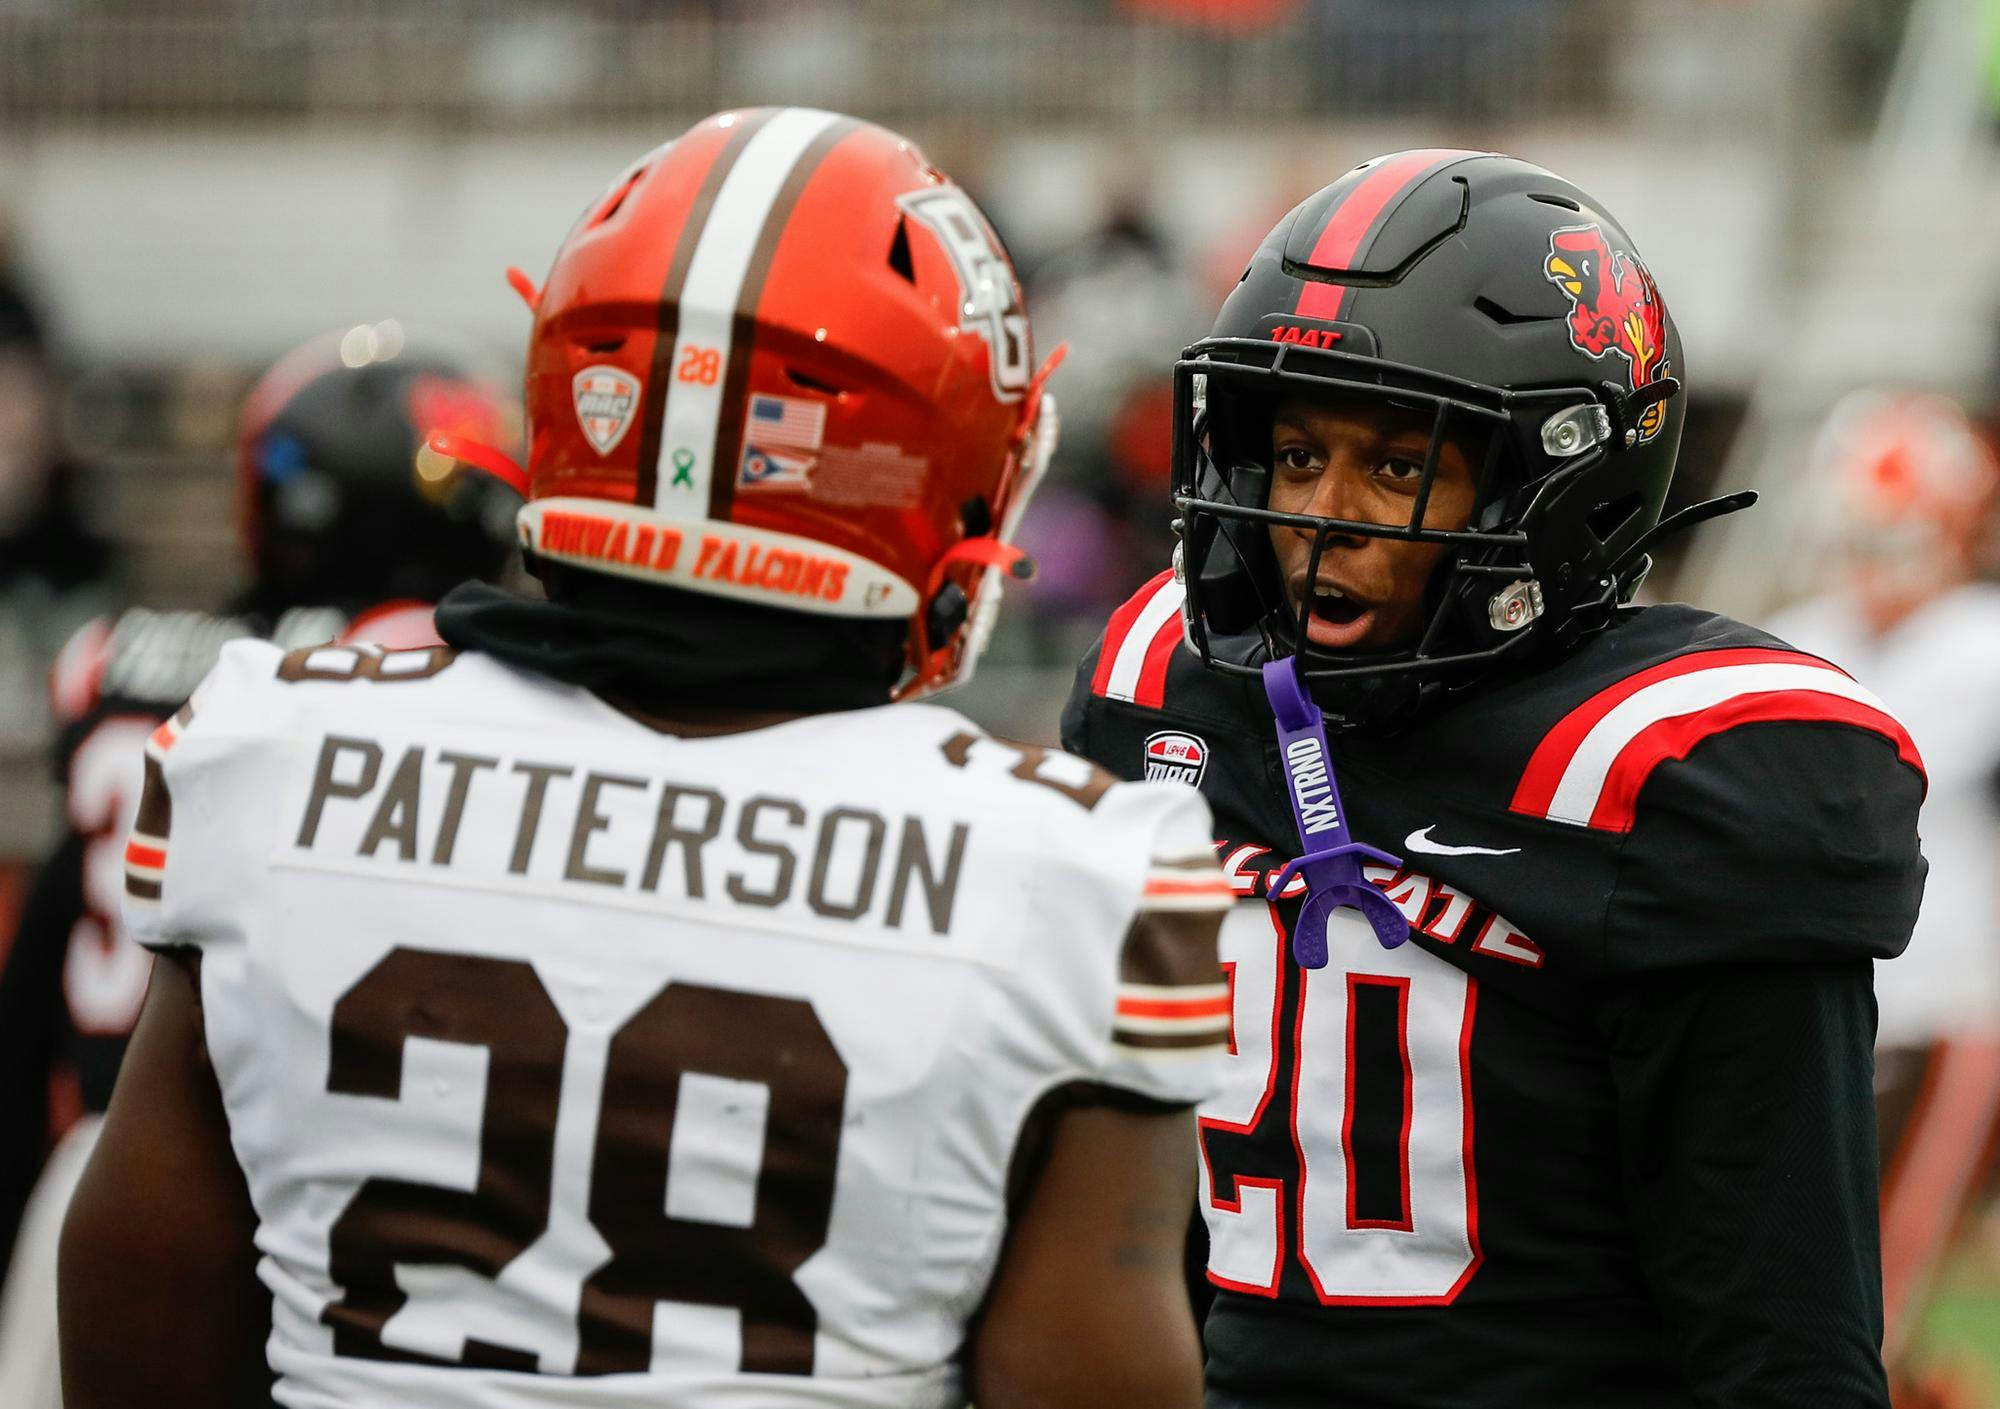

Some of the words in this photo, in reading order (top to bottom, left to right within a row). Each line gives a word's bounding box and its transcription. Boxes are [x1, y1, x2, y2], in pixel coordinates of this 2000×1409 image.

[677, 345, 721, 387] 28
[692, 537, 850, 603] FALCONS
[295, 734, 969, 935] PATTERSON
[1286, 737, 1340, 835] NXTRND
[320, 945, 849, 1376] 28
[1195, 876, 1485, 1306] 20
